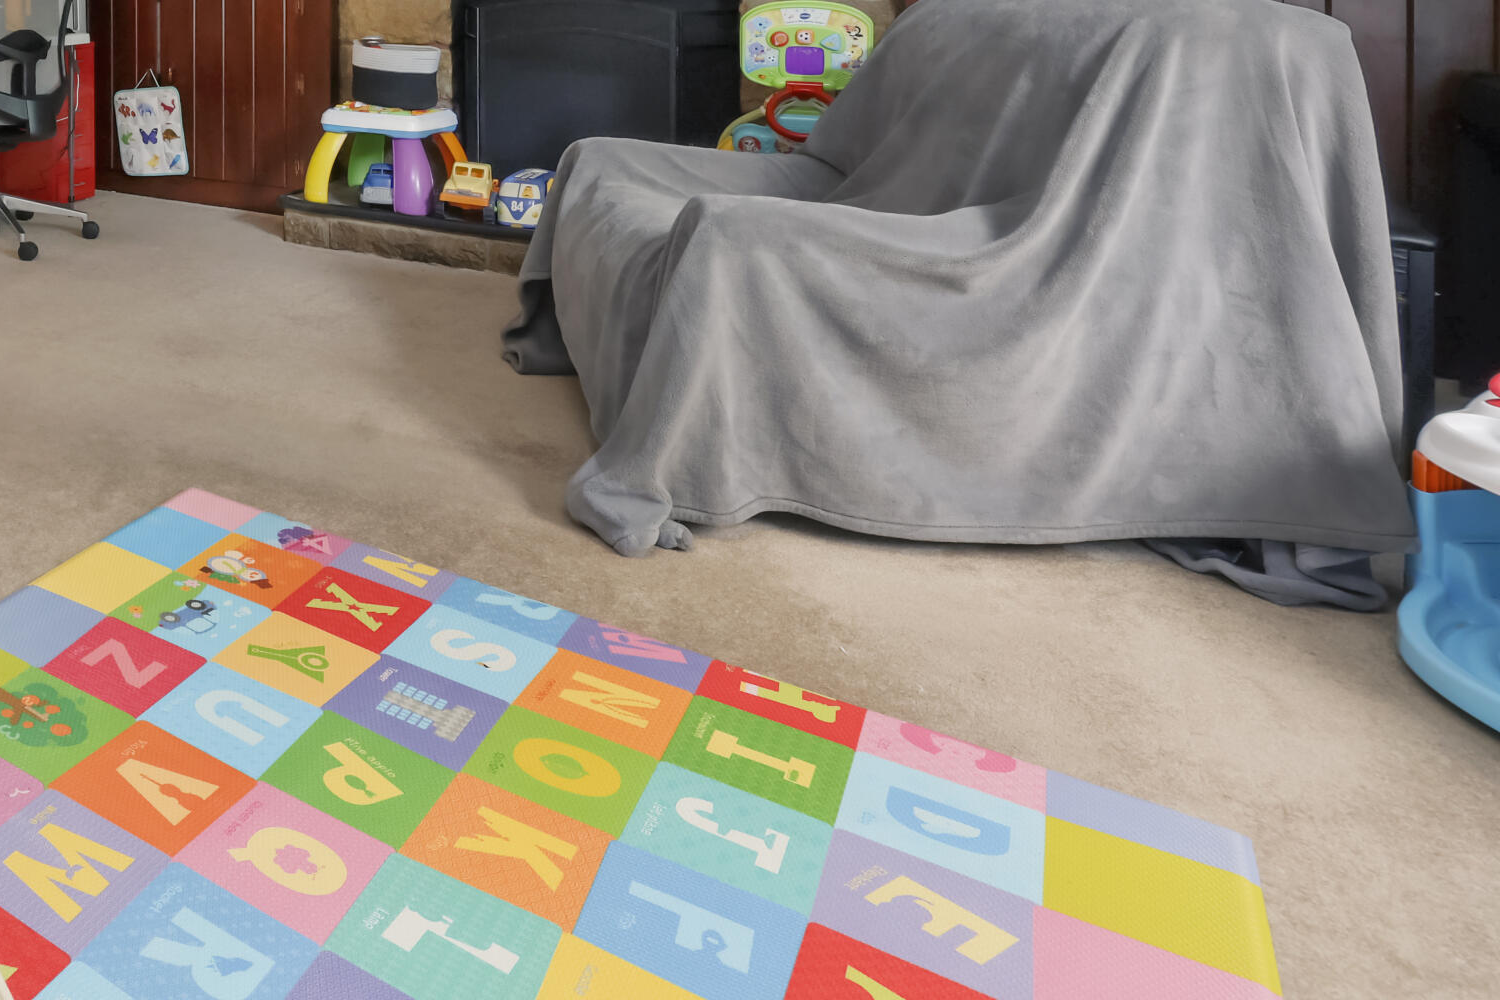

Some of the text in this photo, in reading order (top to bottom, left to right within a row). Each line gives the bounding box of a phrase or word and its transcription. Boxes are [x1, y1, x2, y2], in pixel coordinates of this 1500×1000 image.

[511, 200, 524, 212] 84
[305, 582, 400, 632] X
[80, 638, 168, 689] Z
[430, 629, 517, 672] S
[195, 689, 290, 747] U
[558, 670, 661, 729] N
[322, 741, 404, 806] P
[513, 737, 622, 798] O
[706, 729, 817, 788] I
[453, 805, 578, 892] K
[675, 797, 790, 874] J
[886, 785, 1011, 856] D
[226, 826, 347, 896] Q
[139, 906, 276, 1000] R
[381, 905, 520, 975] L
[628, 880, 754, 974] F
[863, 875, 1020, 966] E
